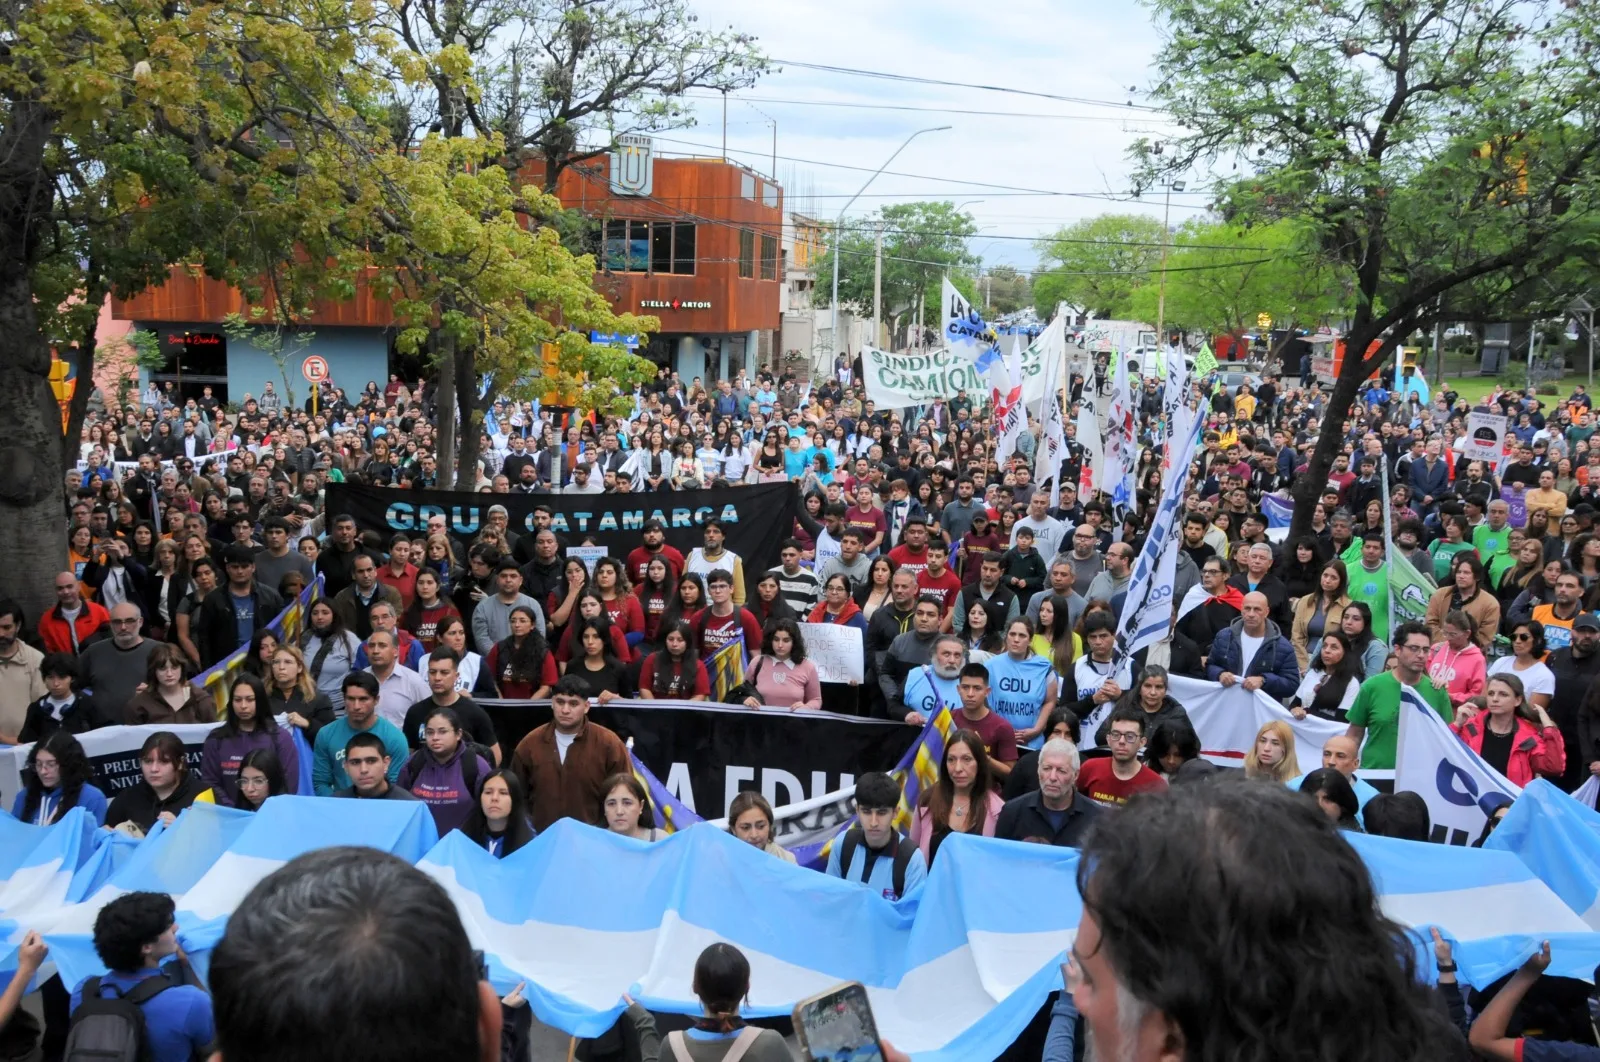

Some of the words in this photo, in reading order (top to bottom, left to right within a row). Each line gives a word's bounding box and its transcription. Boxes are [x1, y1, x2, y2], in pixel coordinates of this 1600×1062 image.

[617, 136, 651, 145] DISTRITO
[616, 145, 650, 191] U
[950, 294, 965, 321] LA
[705, 629, 730, 637] FRANJA
[840, 628, 855, 637] NO
[840, 642, 855, 653] SE
[1430, 662, 1456, 680] GAP
[999, 677, 1031, 693] GDU
[110, 777, 144, 791] NIVE
[1094, 792, 1115, 802] FRANJA
